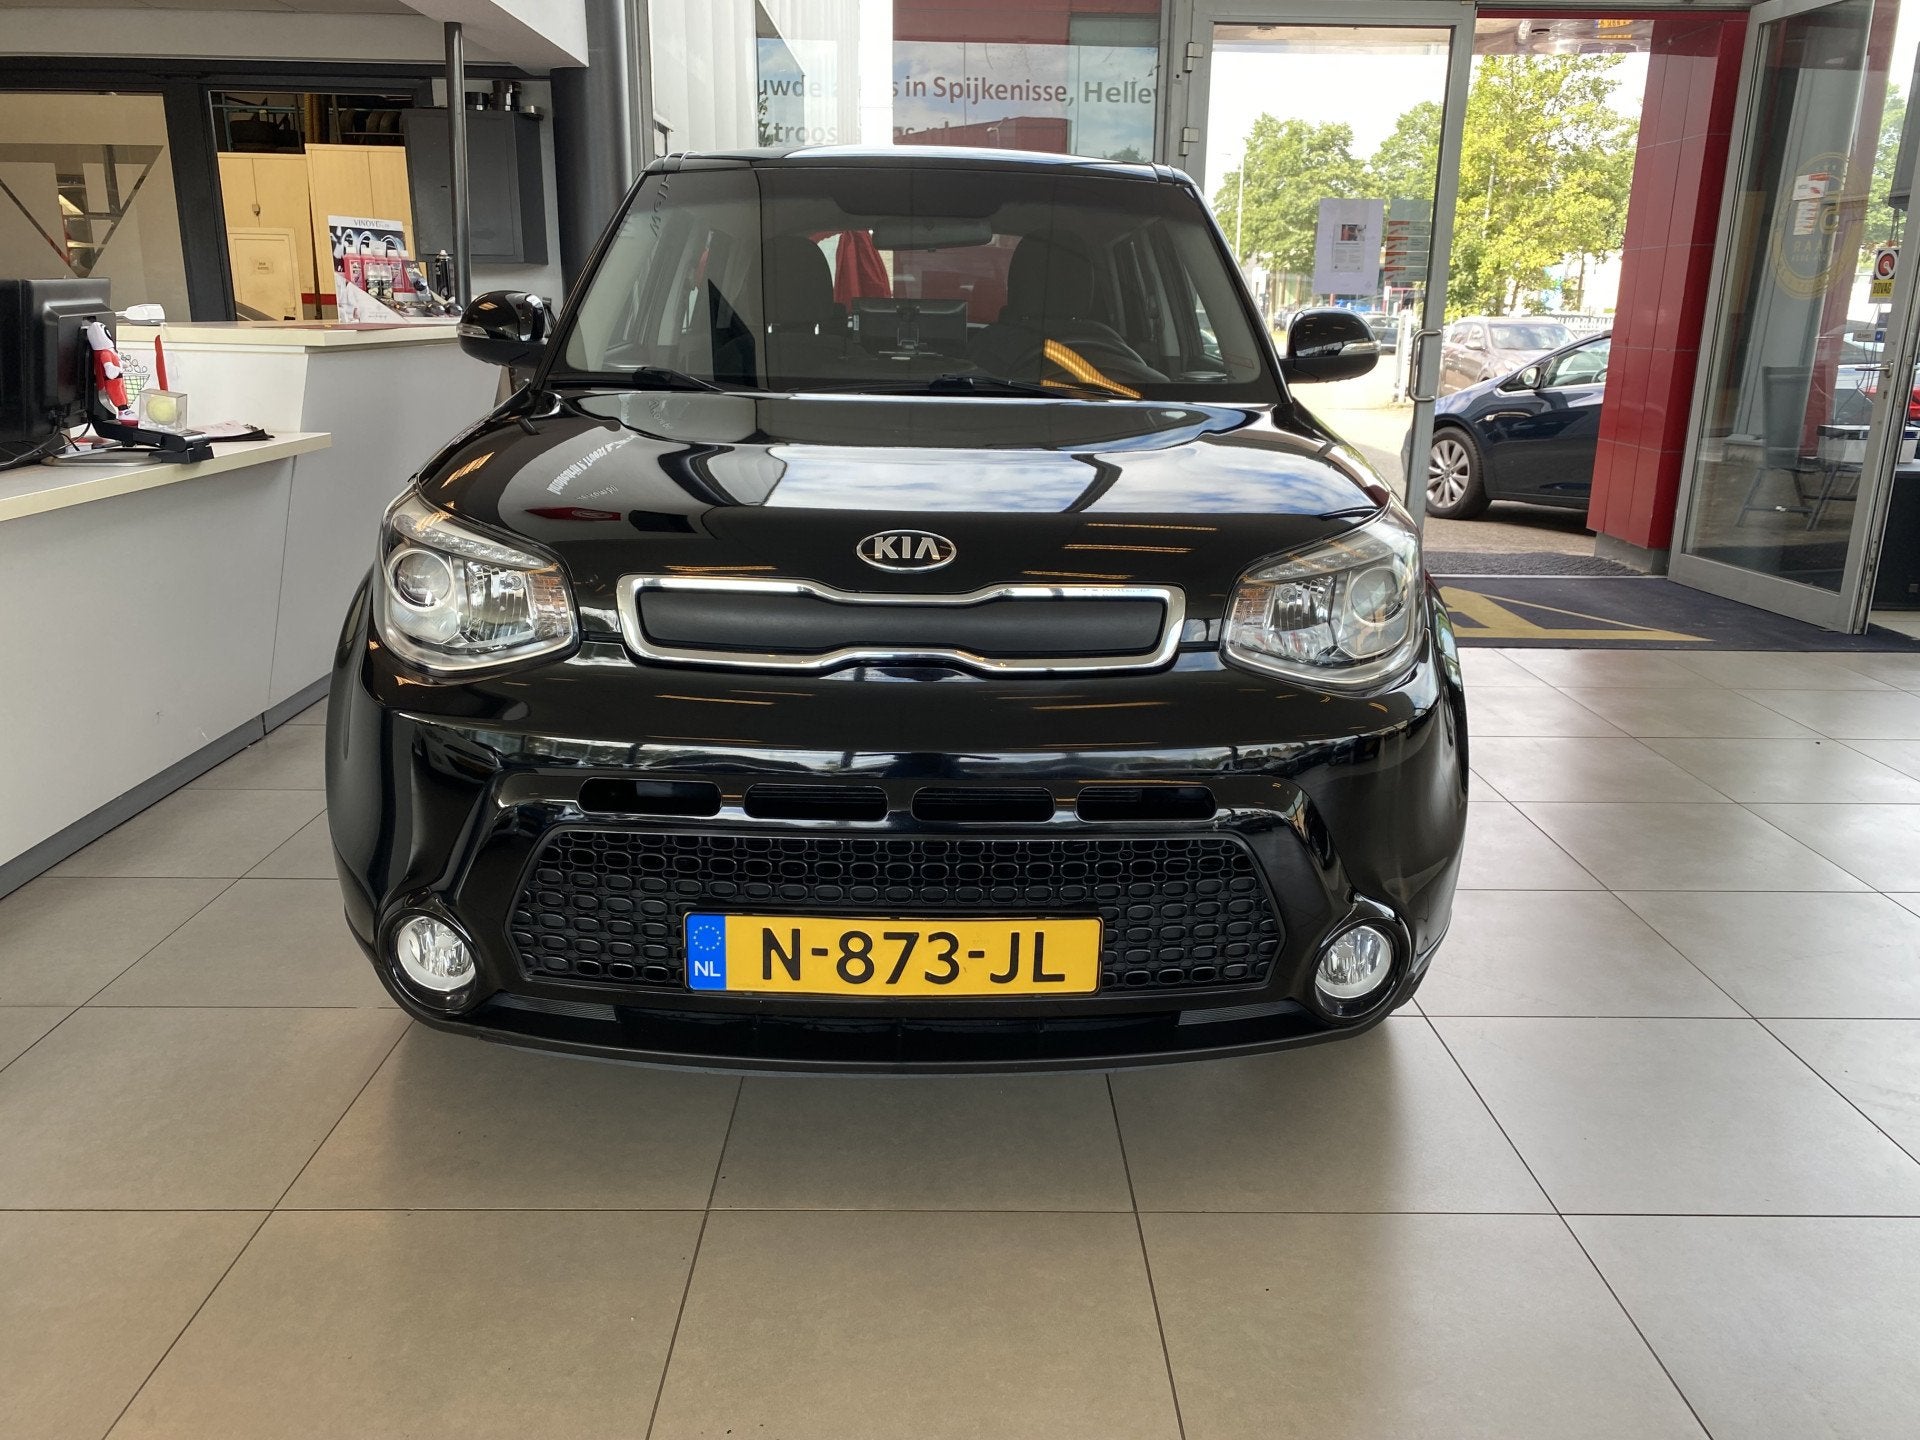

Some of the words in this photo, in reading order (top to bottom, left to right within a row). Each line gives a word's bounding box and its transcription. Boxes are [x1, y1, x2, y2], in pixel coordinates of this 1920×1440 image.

[905, 75, 926, 98] in
[932, 75, 1075, 106] Spijkenisse,
[874, 536, 941, 560] KIA
[694, 960, 721, 978] NL
[762, 926, 1066, 985] N-873-JL
